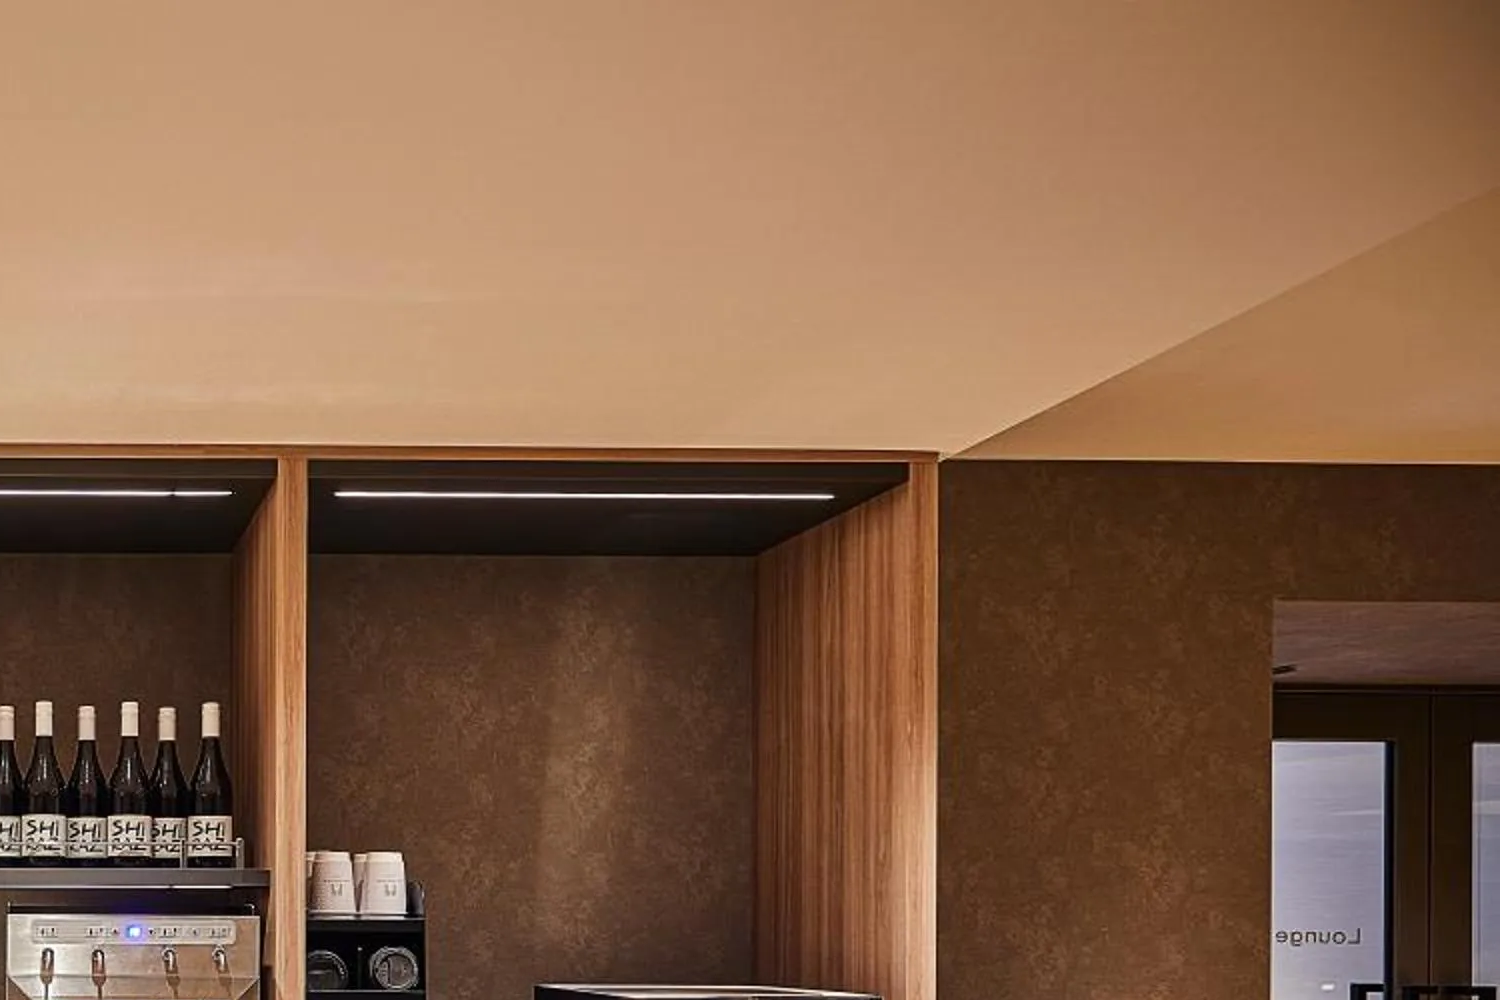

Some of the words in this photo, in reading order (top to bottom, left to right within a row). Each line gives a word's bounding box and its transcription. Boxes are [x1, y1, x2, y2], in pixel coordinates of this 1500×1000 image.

[26, 819, 59, 836] SHI
[69, 822, 101, 838] SHI
[112, 820, 145, 836] SHI
[193, 821, 225, 836] SHI
